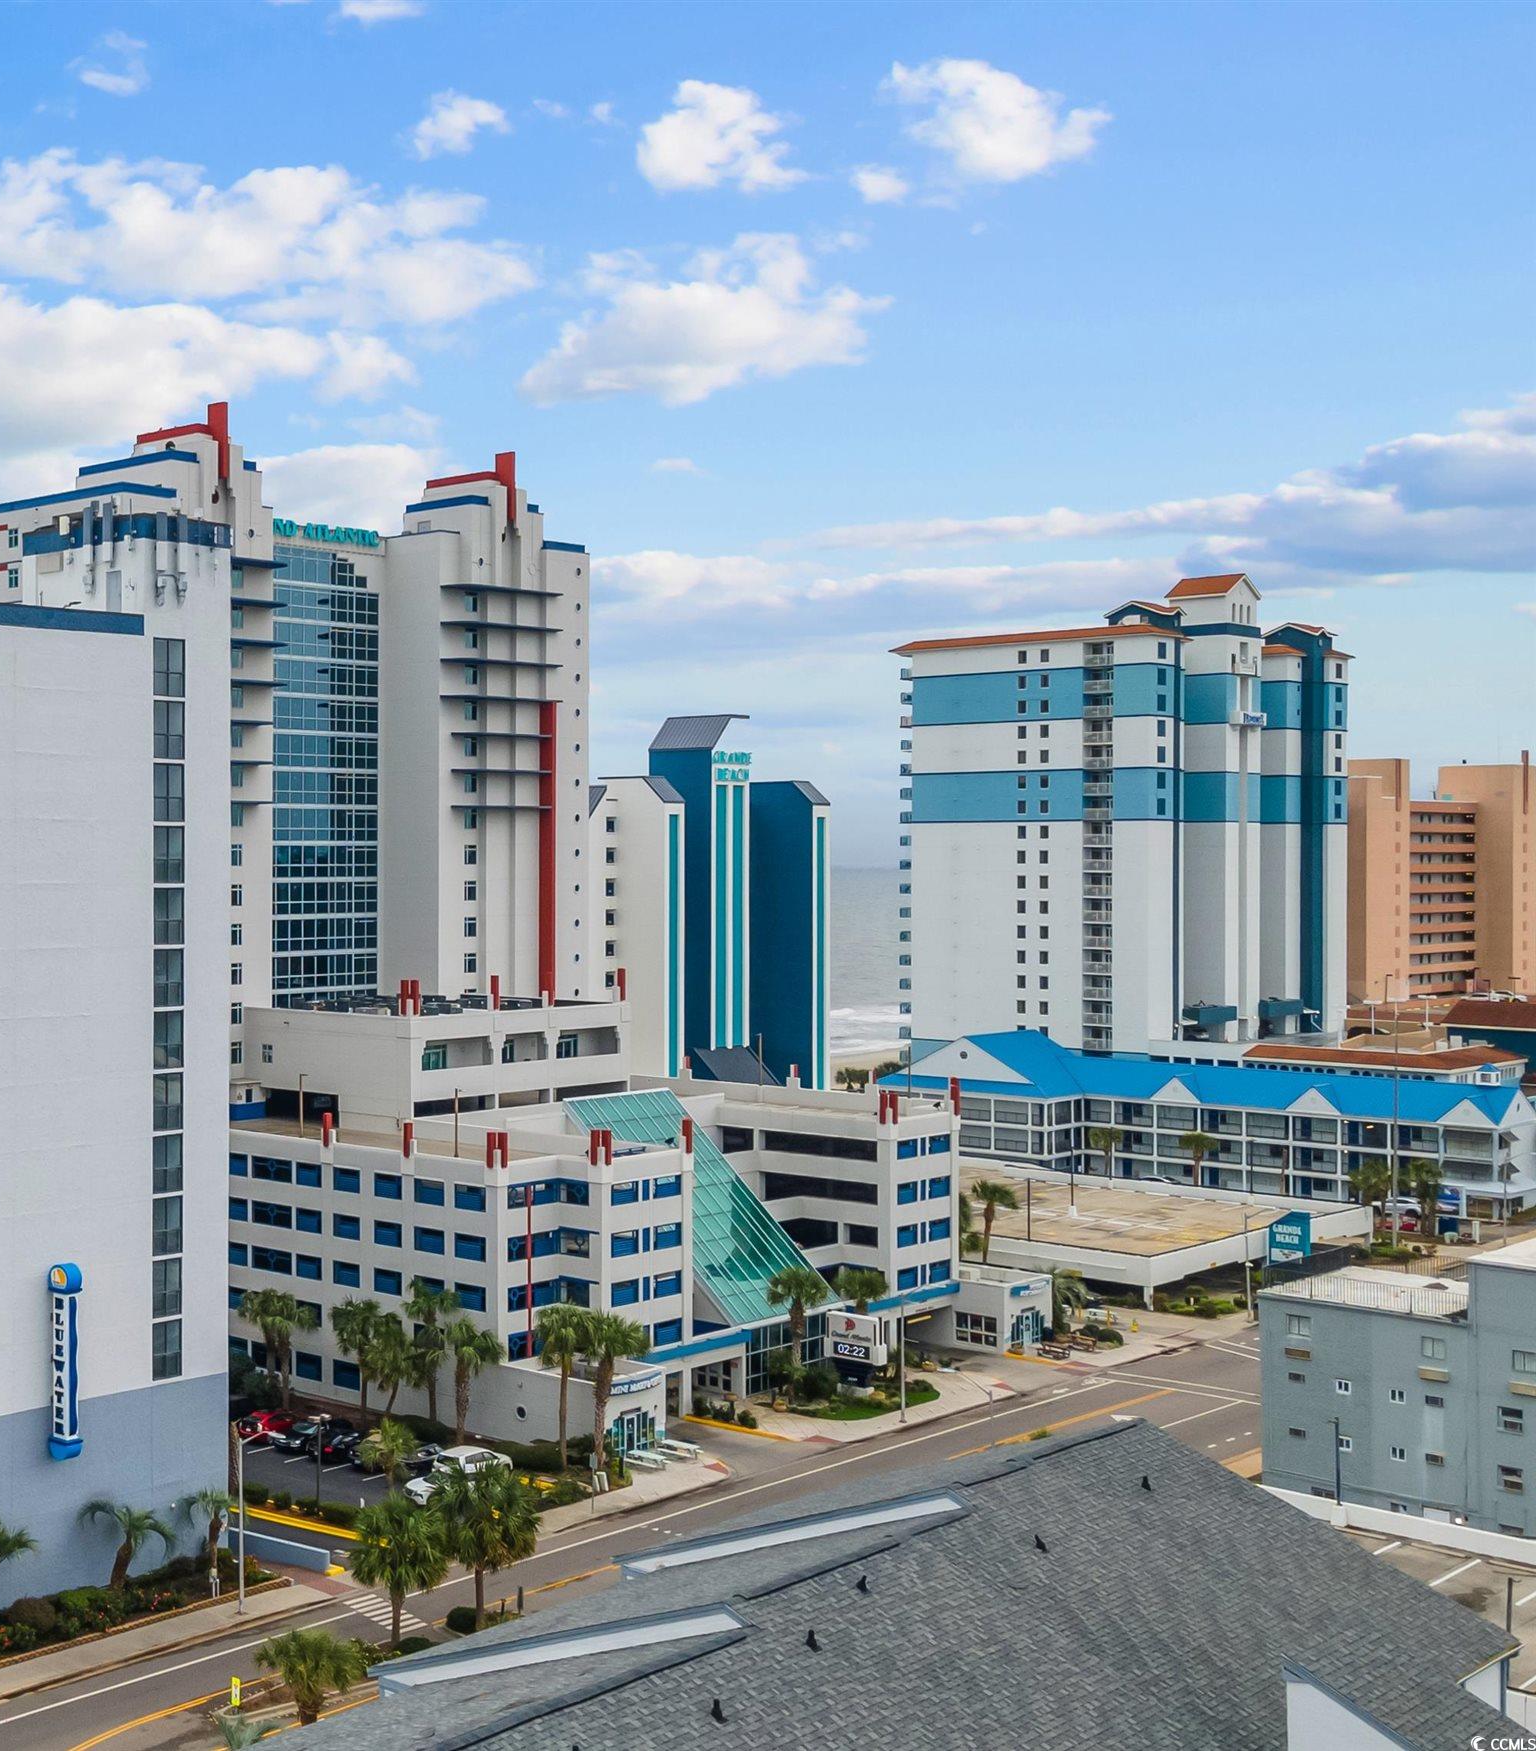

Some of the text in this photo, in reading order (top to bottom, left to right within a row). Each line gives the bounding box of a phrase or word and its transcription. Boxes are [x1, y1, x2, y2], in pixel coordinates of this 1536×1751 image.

[273, 517, 379, 546] ND ATLANTIC
[712, 751, 752, 765] GRANDE
[716, 768, 749, 782] BEACH
[1275, 1233, 1299, 1244] BEACH
[837, 1344, 865, 1357] 02:22
[54, 1296, 65, 1435] BLUEWATER
